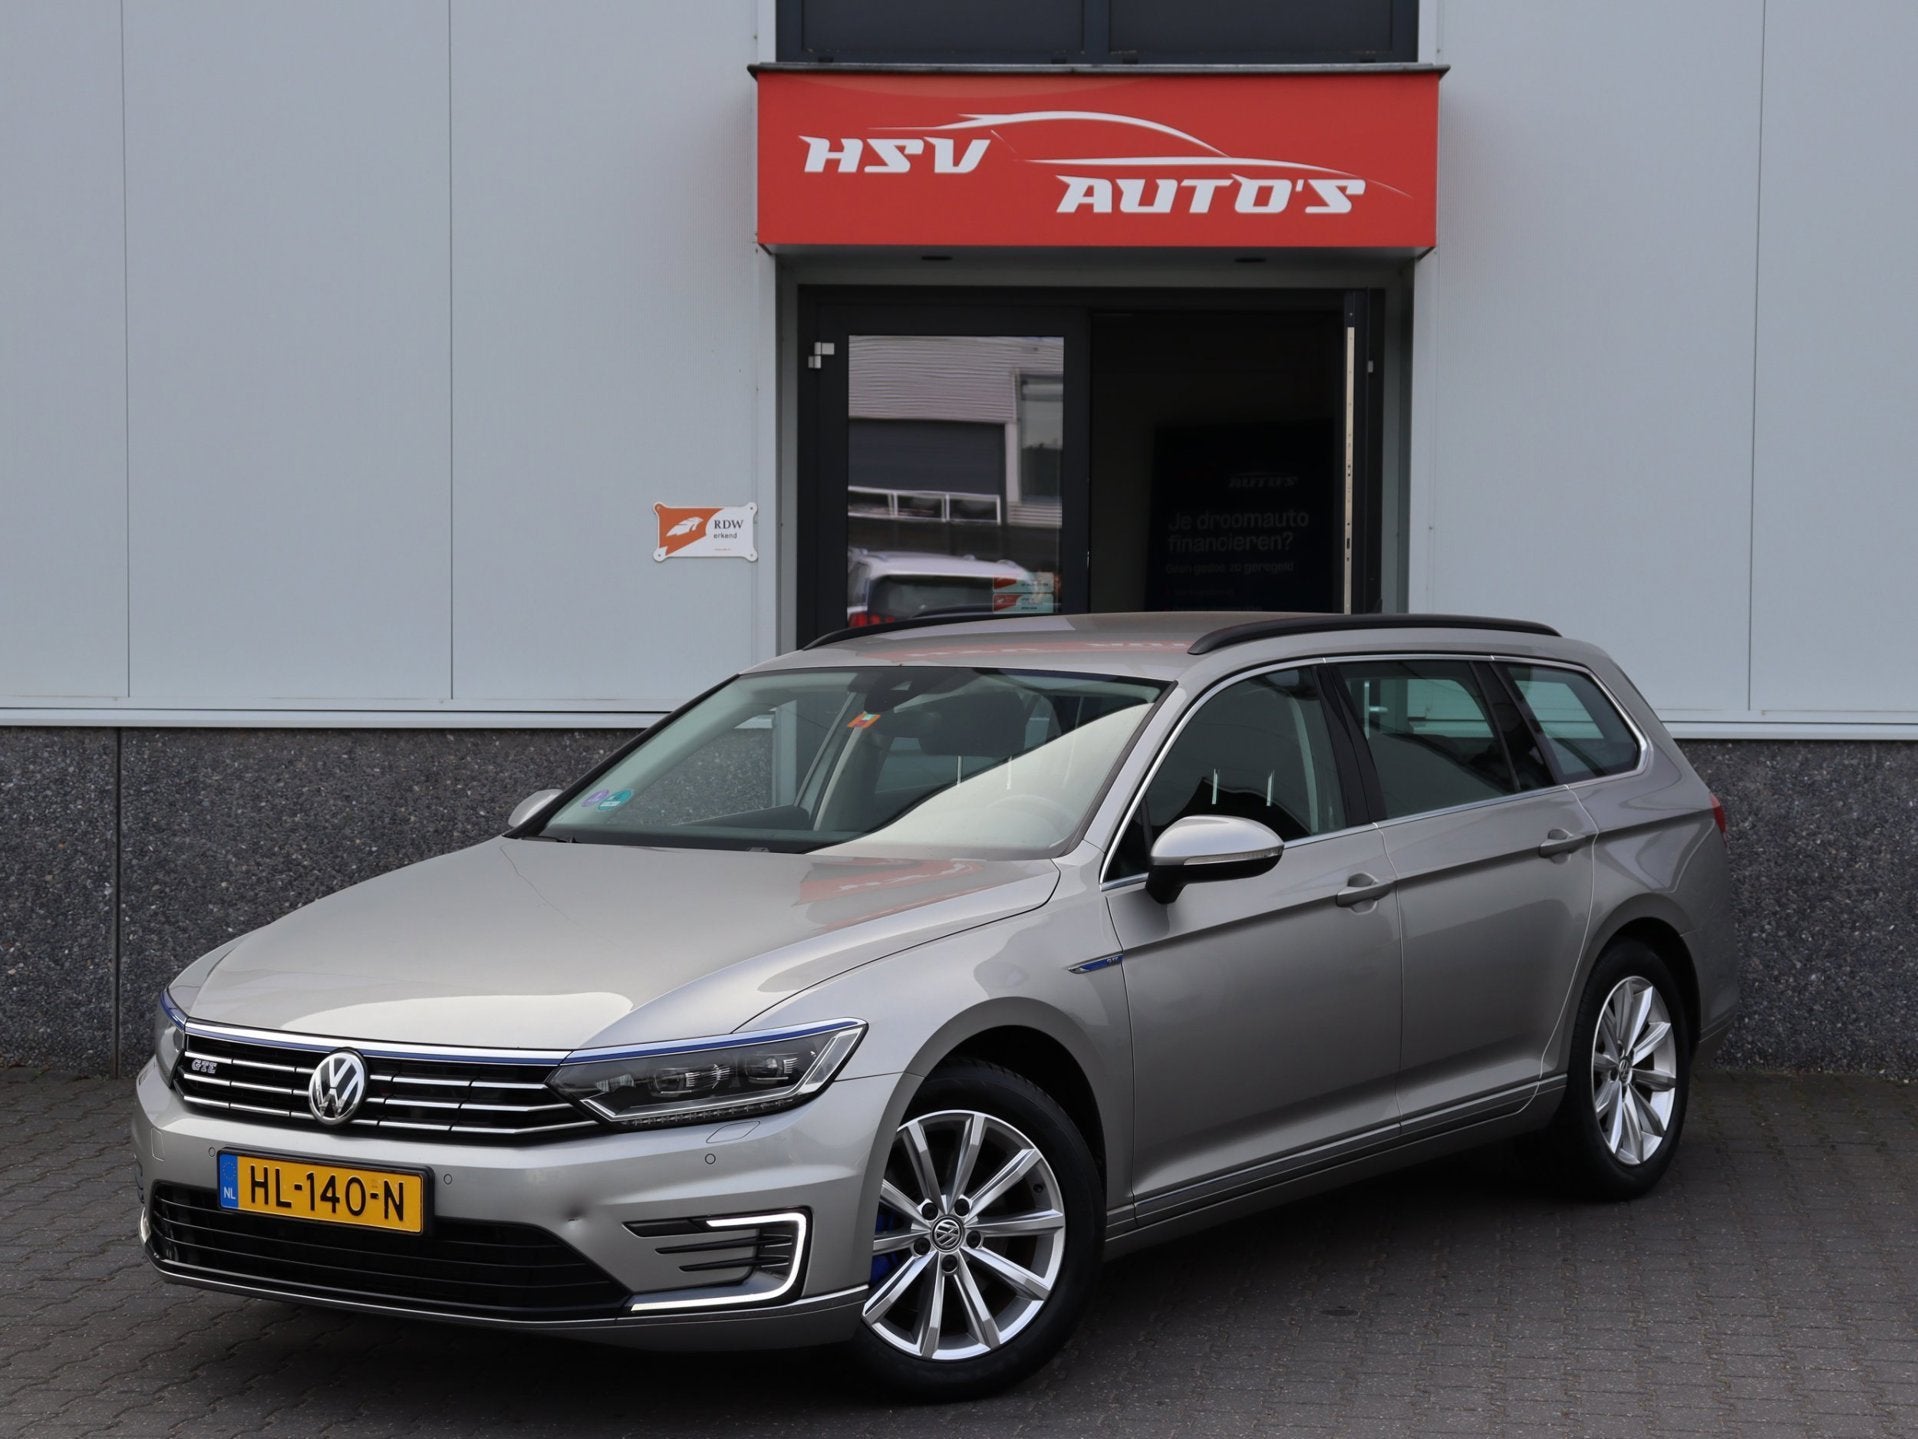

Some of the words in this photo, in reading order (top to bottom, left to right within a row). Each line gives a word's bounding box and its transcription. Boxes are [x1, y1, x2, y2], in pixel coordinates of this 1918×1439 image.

[799, 135, 991, 173] HSV
[1056, 173, 1366, 214] AUTO'S
[714, 519, 743, 529] RDW
[1168, 511, 1192, 531] Je
[1196, 509, 1310, 530] droomauto
[1167, 531, 1295, 554] financieren?
[191, 1058, 218, 1074] GTE
[223, 1185, 237, 1200] NL
[251, 1165, 404, 1221] HL-140-N
